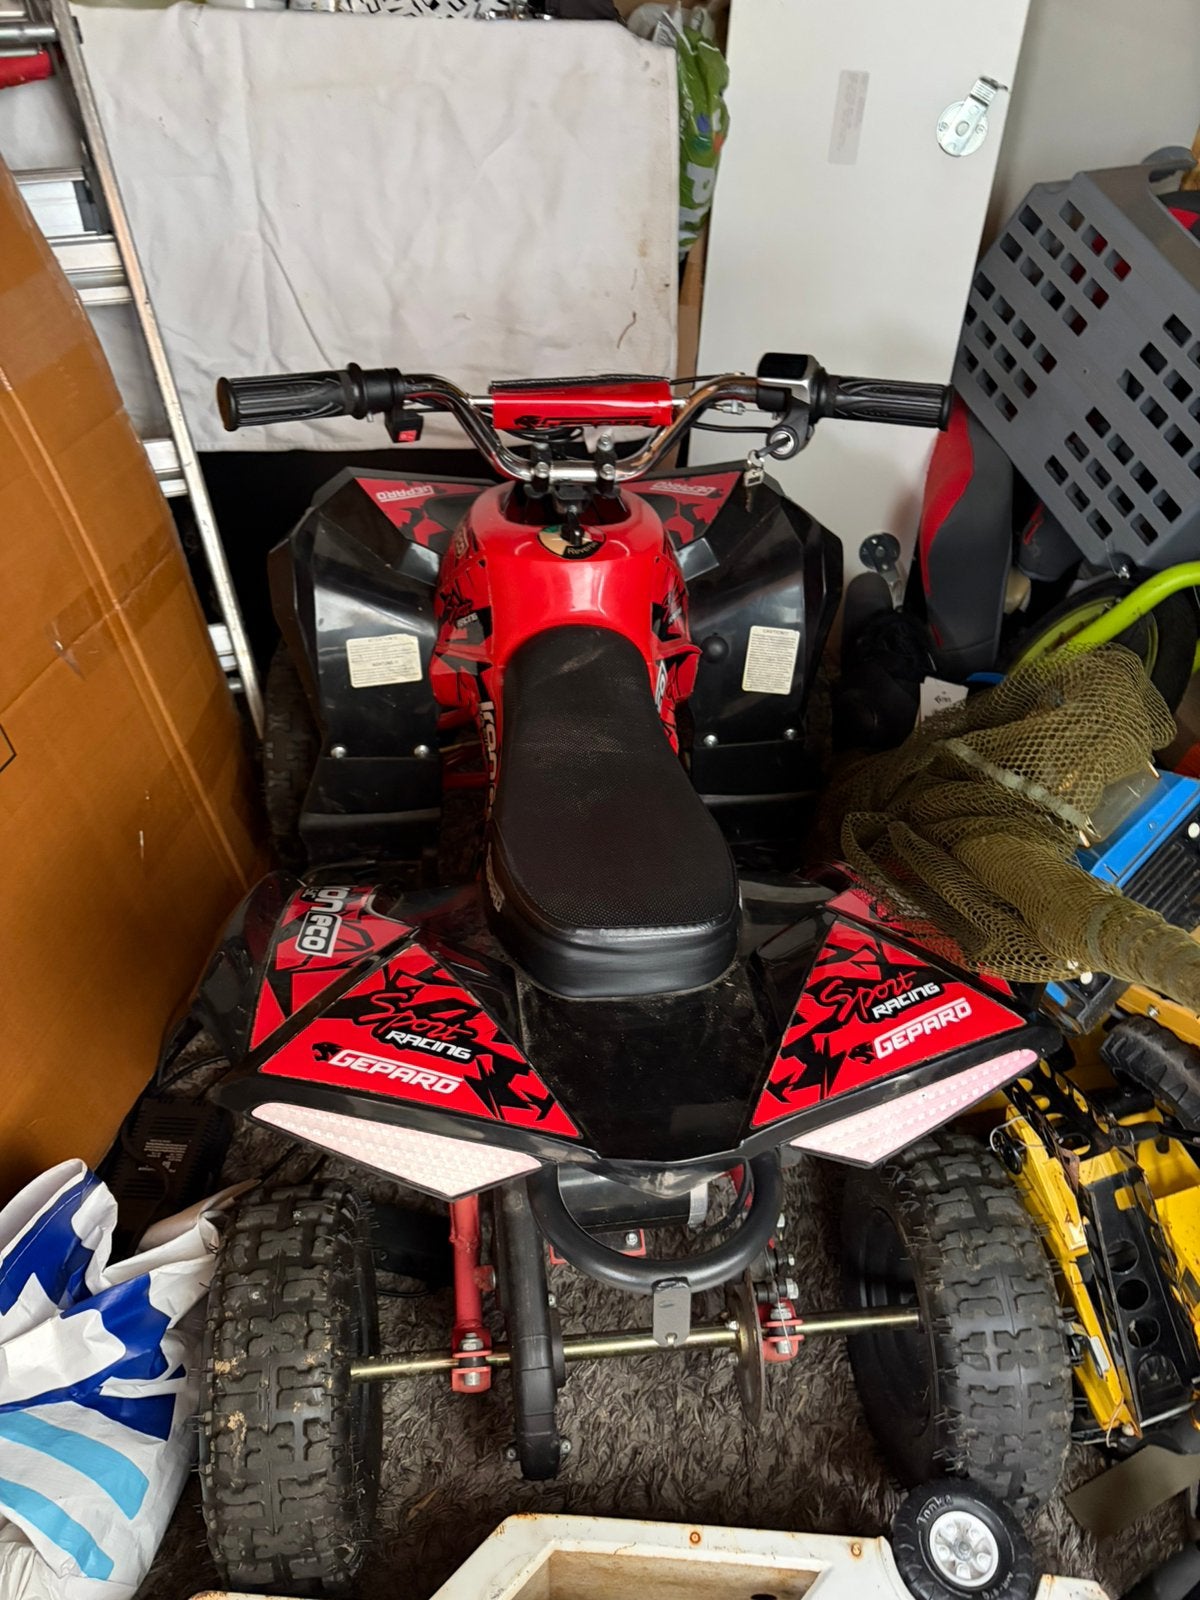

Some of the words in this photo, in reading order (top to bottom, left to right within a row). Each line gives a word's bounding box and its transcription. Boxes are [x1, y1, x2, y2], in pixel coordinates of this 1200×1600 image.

[359, 992, 475, 1041] Sport
[820, 972, 917, 1021] Sport
[871, 981, 940, 1019] RACING
[385, 1029, 472, 1060] RACING
[873, 997, 973, 1060] GEPARD
[328, 1049, 465, 1094] GEPARD
